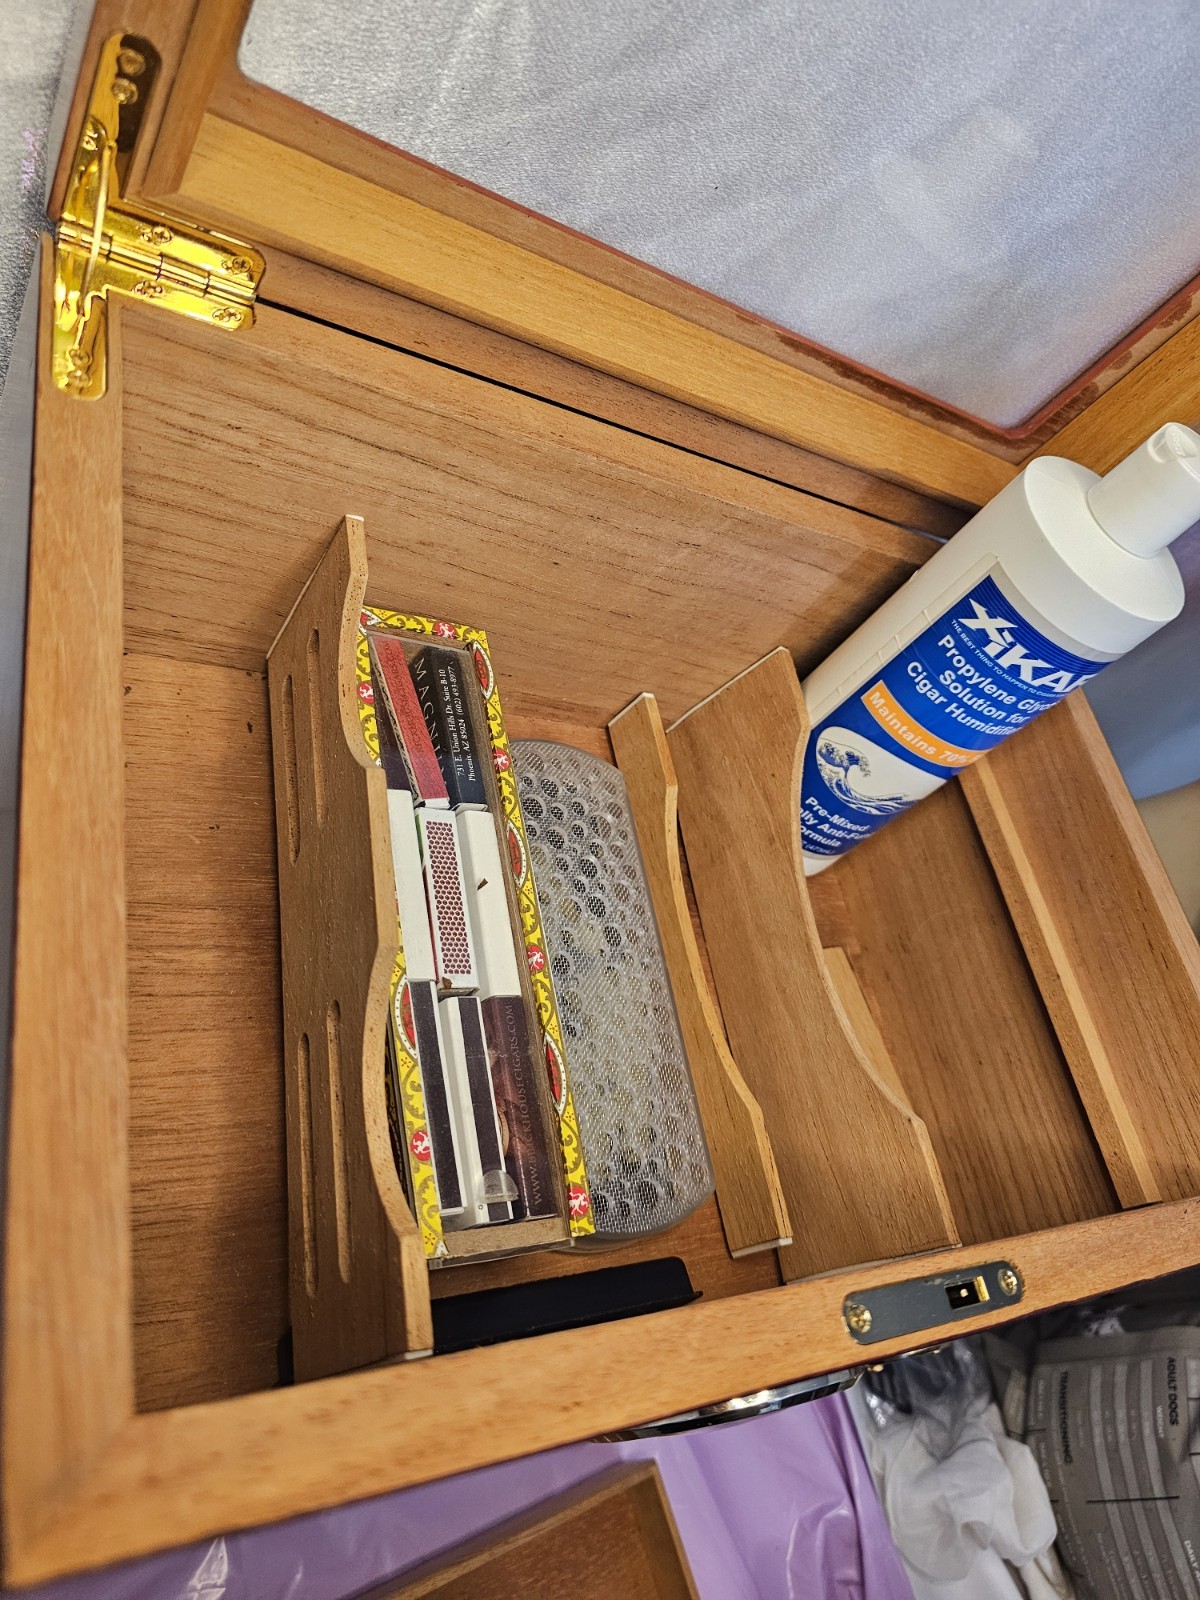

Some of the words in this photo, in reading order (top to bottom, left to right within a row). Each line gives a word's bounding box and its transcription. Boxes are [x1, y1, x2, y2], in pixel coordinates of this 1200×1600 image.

[951, 619, 963, 634] THE
[960, 633, 976, 650] BEST
[974, 649, 994, 668] THING
[993, 666, 1004, 675] TO
[1001, 673, 1029, 691] HAPPEN
[438, 669, 448, 685] B-10
[937, 634, 1018, 705] Propylene
[443, 686, 451, 702] Suite
[907, 661, 948, 705] Cigar
[445, 703, 454, 714] Dr.
[455, 697, 465, 716] (602)
[939, 669, 1008, 720] Solution
[1005, 713, 1031, 724] for
[447, 715, 457, 731] Hills
[458, 718, 468, 740] 85024
[869, 691, 937, 755] Maintains
[938, 750, 969, 763] 70%
[452, 732, 461, 753] Union
[462, 741, 471, 752] AZ
[454, 754, 463, 762] E.
[457, 763, 466, 777] 731
[805, 796, 871, 832] Pre-Mixed
[800, 825, 842, 847] ormula
[1166, 1355, 1178, 1392] ADULT
[1060, 1370, 1074, 1465] TRANSITIONING
[1156, 1404, 1165, 1438] WEIGHT
[1168, 1393, 1179, 1427] DOGS
[1183, 1539, 1199, 1569] DAILY
